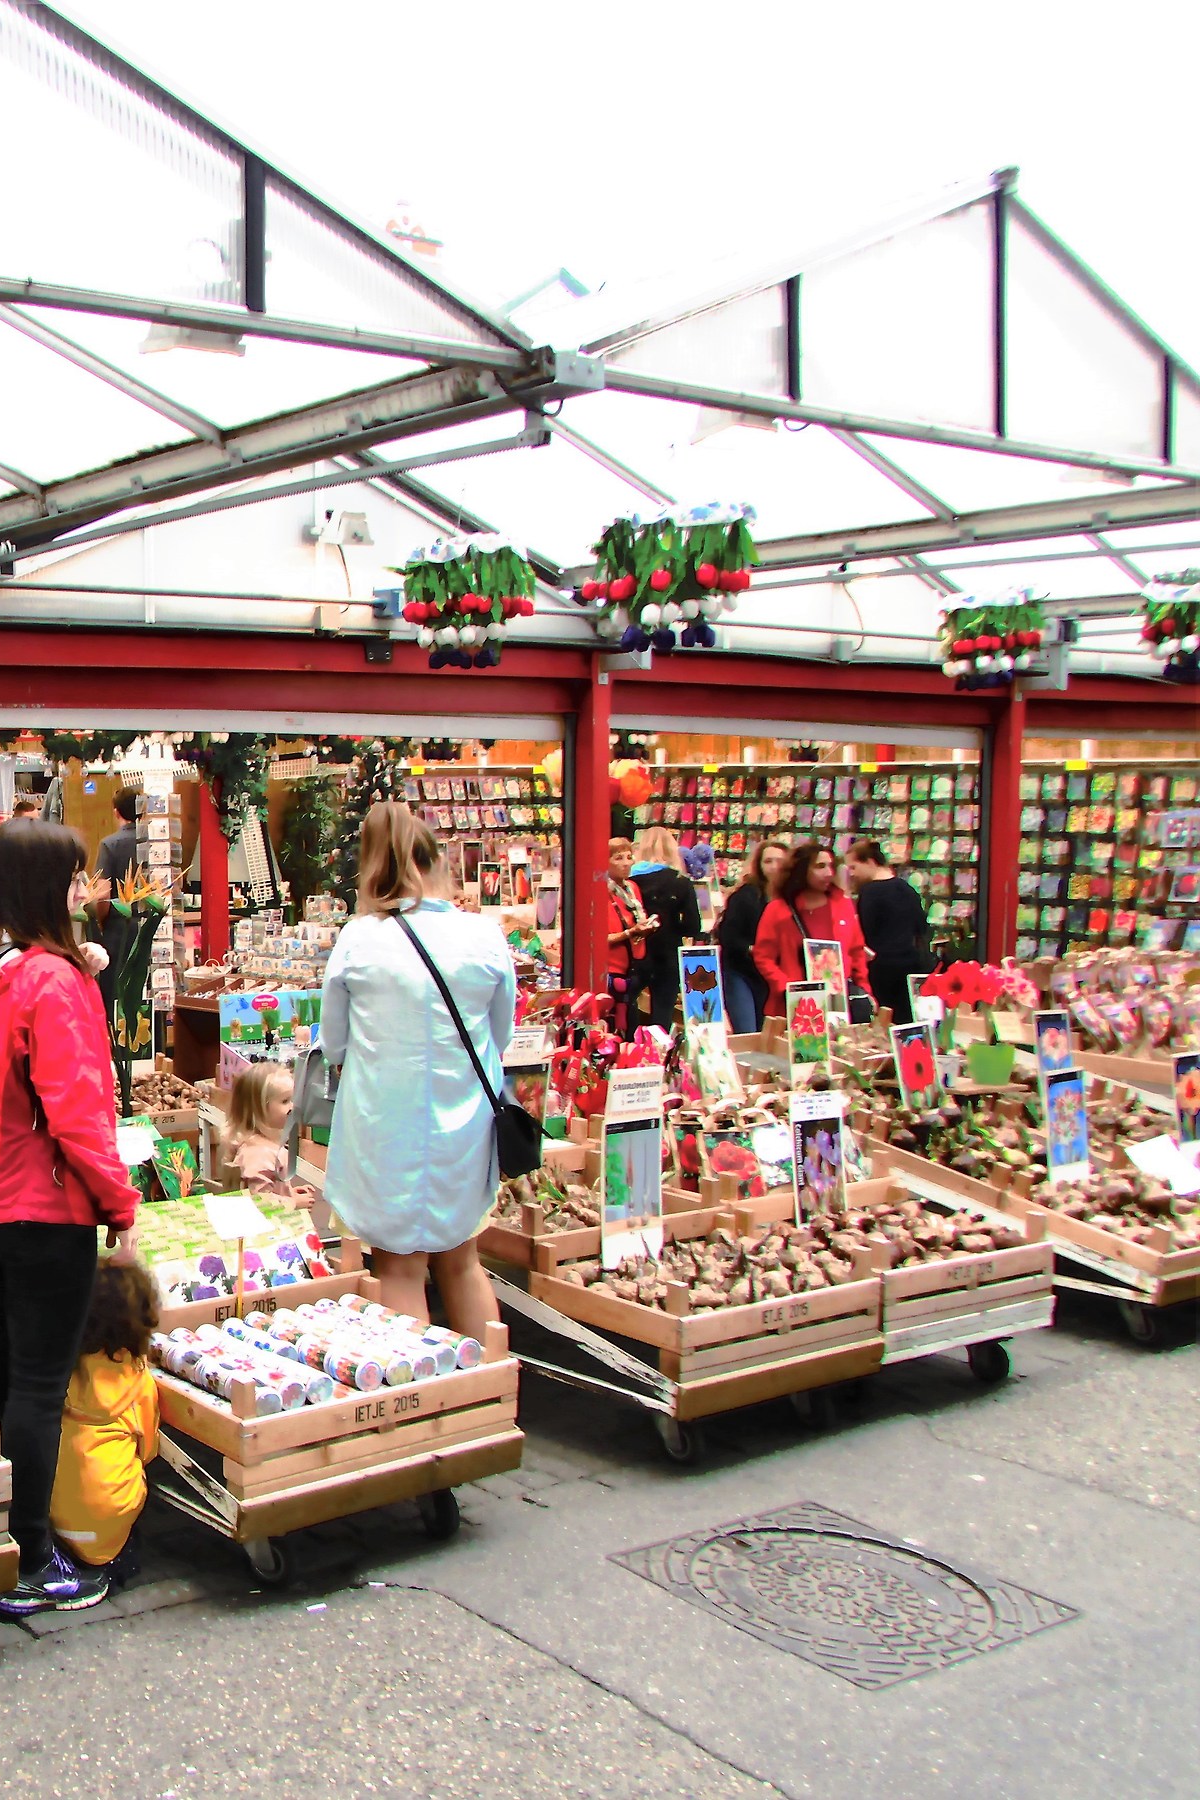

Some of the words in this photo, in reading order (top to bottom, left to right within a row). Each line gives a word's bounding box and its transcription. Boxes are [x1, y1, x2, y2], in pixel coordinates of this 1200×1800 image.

[253, 1297, 277, 1313] 2015
[355, 1401, 386, 1423] IETJE
[393, 1392, 420, 1414] 2015
